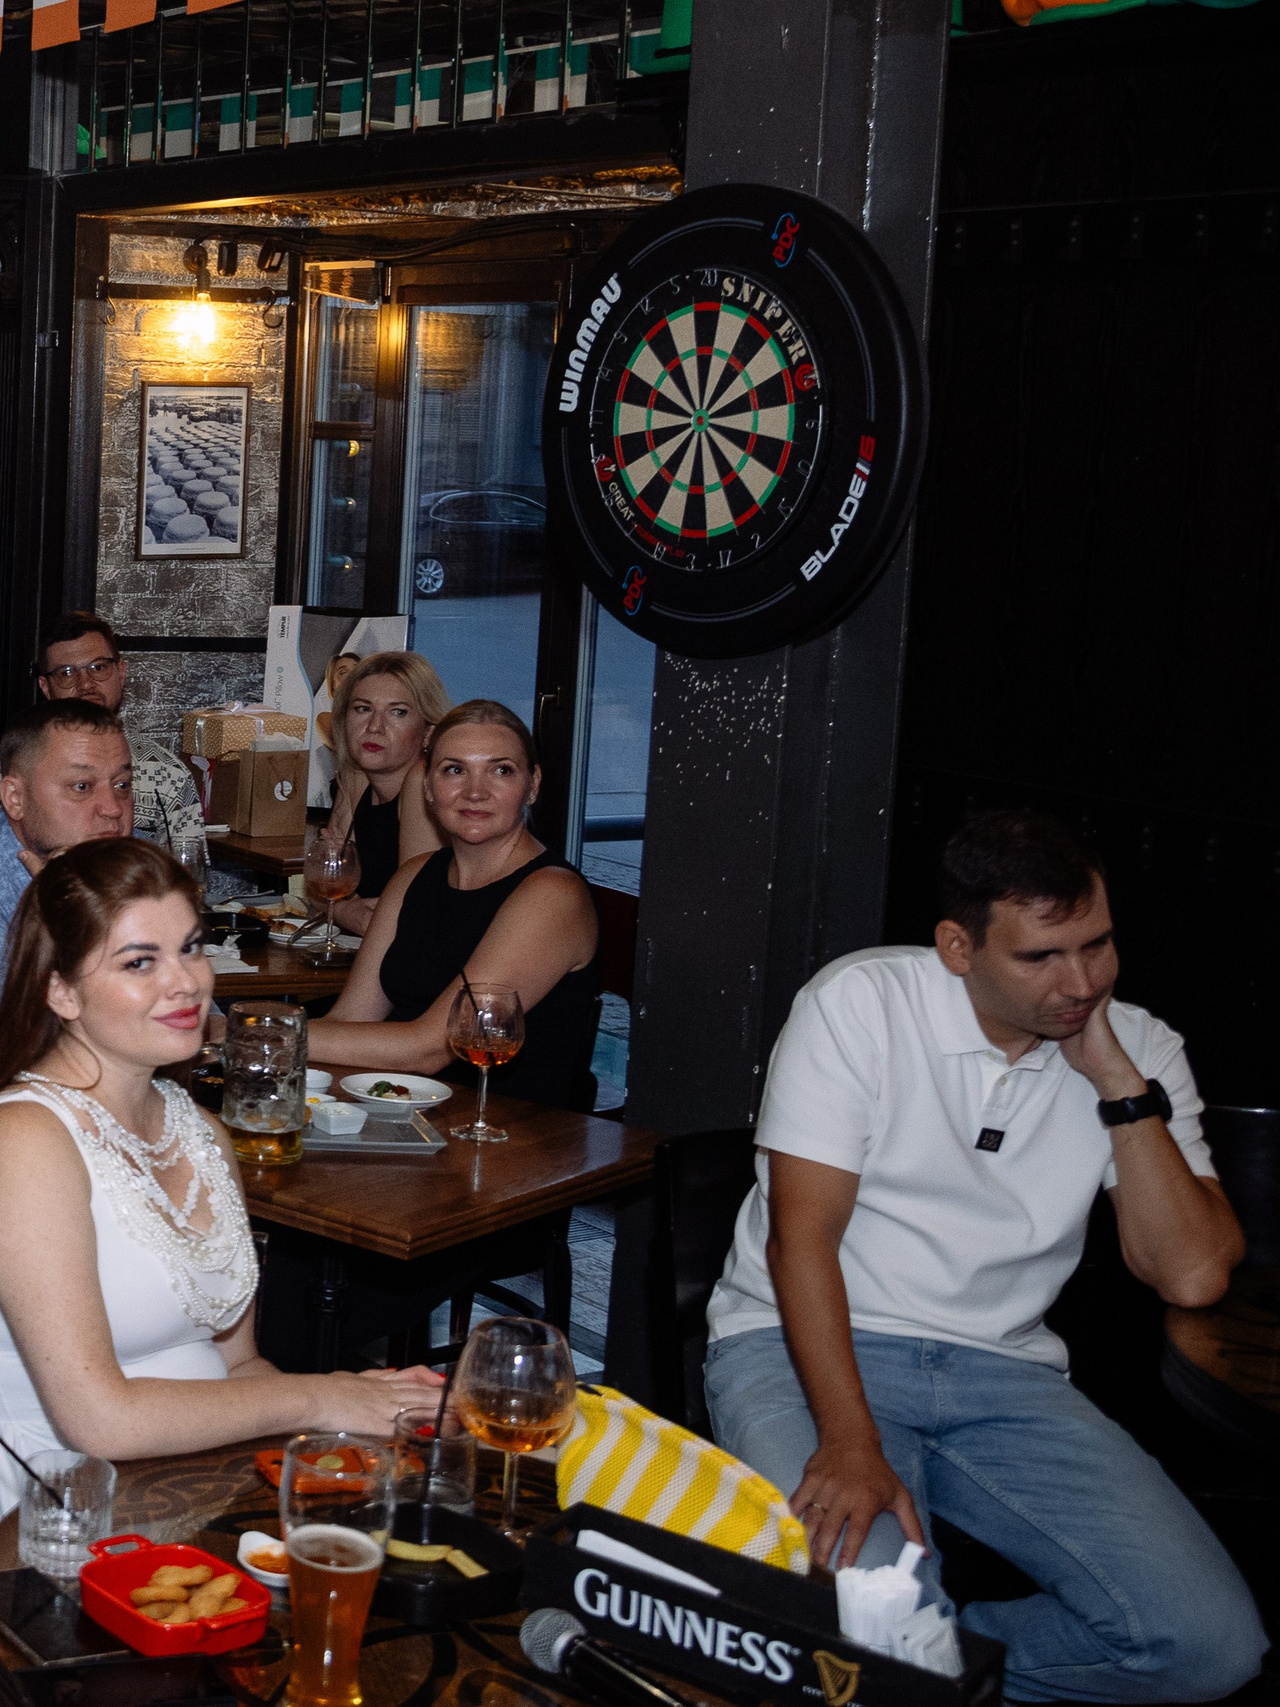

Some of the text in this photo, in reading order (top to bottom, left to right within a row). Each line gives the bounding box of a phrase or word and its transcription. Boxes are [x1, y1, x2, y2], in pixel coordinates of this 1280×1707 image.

[700, 270, 718, 287] 20
[721, 276, 807, 366] SNIPER
[559, 273, 622, 413] WINMAU
[608, 481, 635, 521] GREAT
[799, 472, 868, 582] BLADE
[573, 1567, 795, 1684] GUINNESS
